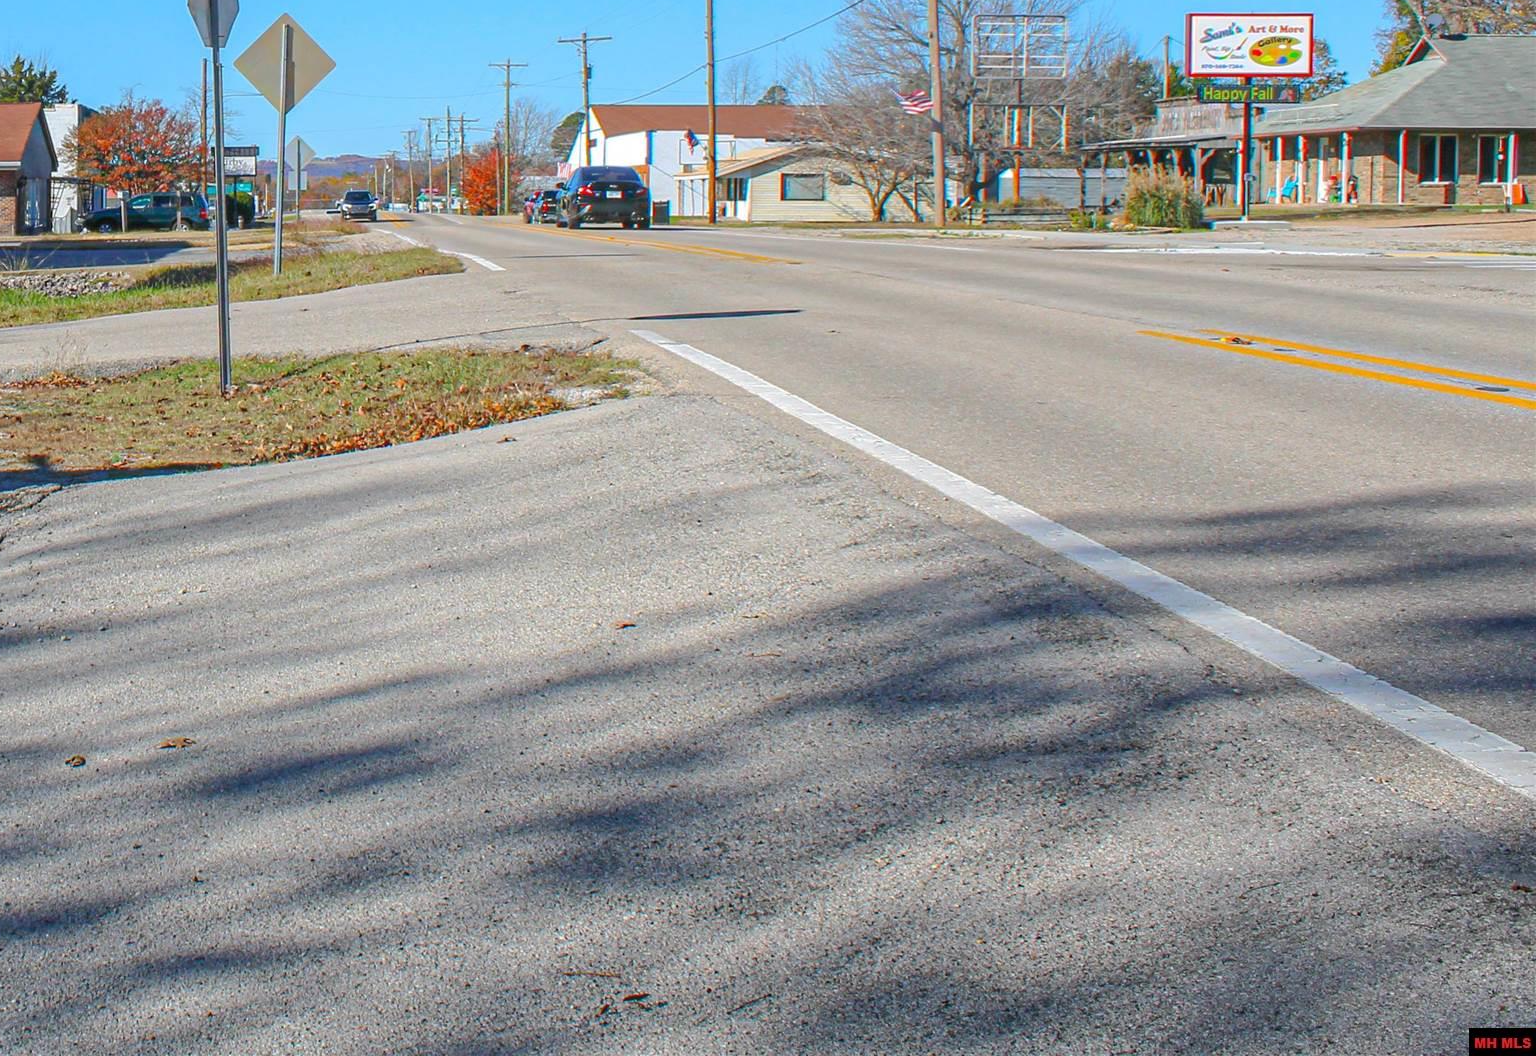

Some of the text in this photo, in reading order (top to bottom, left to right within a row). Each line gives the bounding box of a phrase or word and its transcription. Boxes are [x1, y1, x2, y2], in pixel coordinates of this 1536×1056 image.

[1248, 25, 1305, 34] Art & More
[1257, 35, 1292, 48] Gallery
[1203, 87, 1273, 101] Happy Fall
